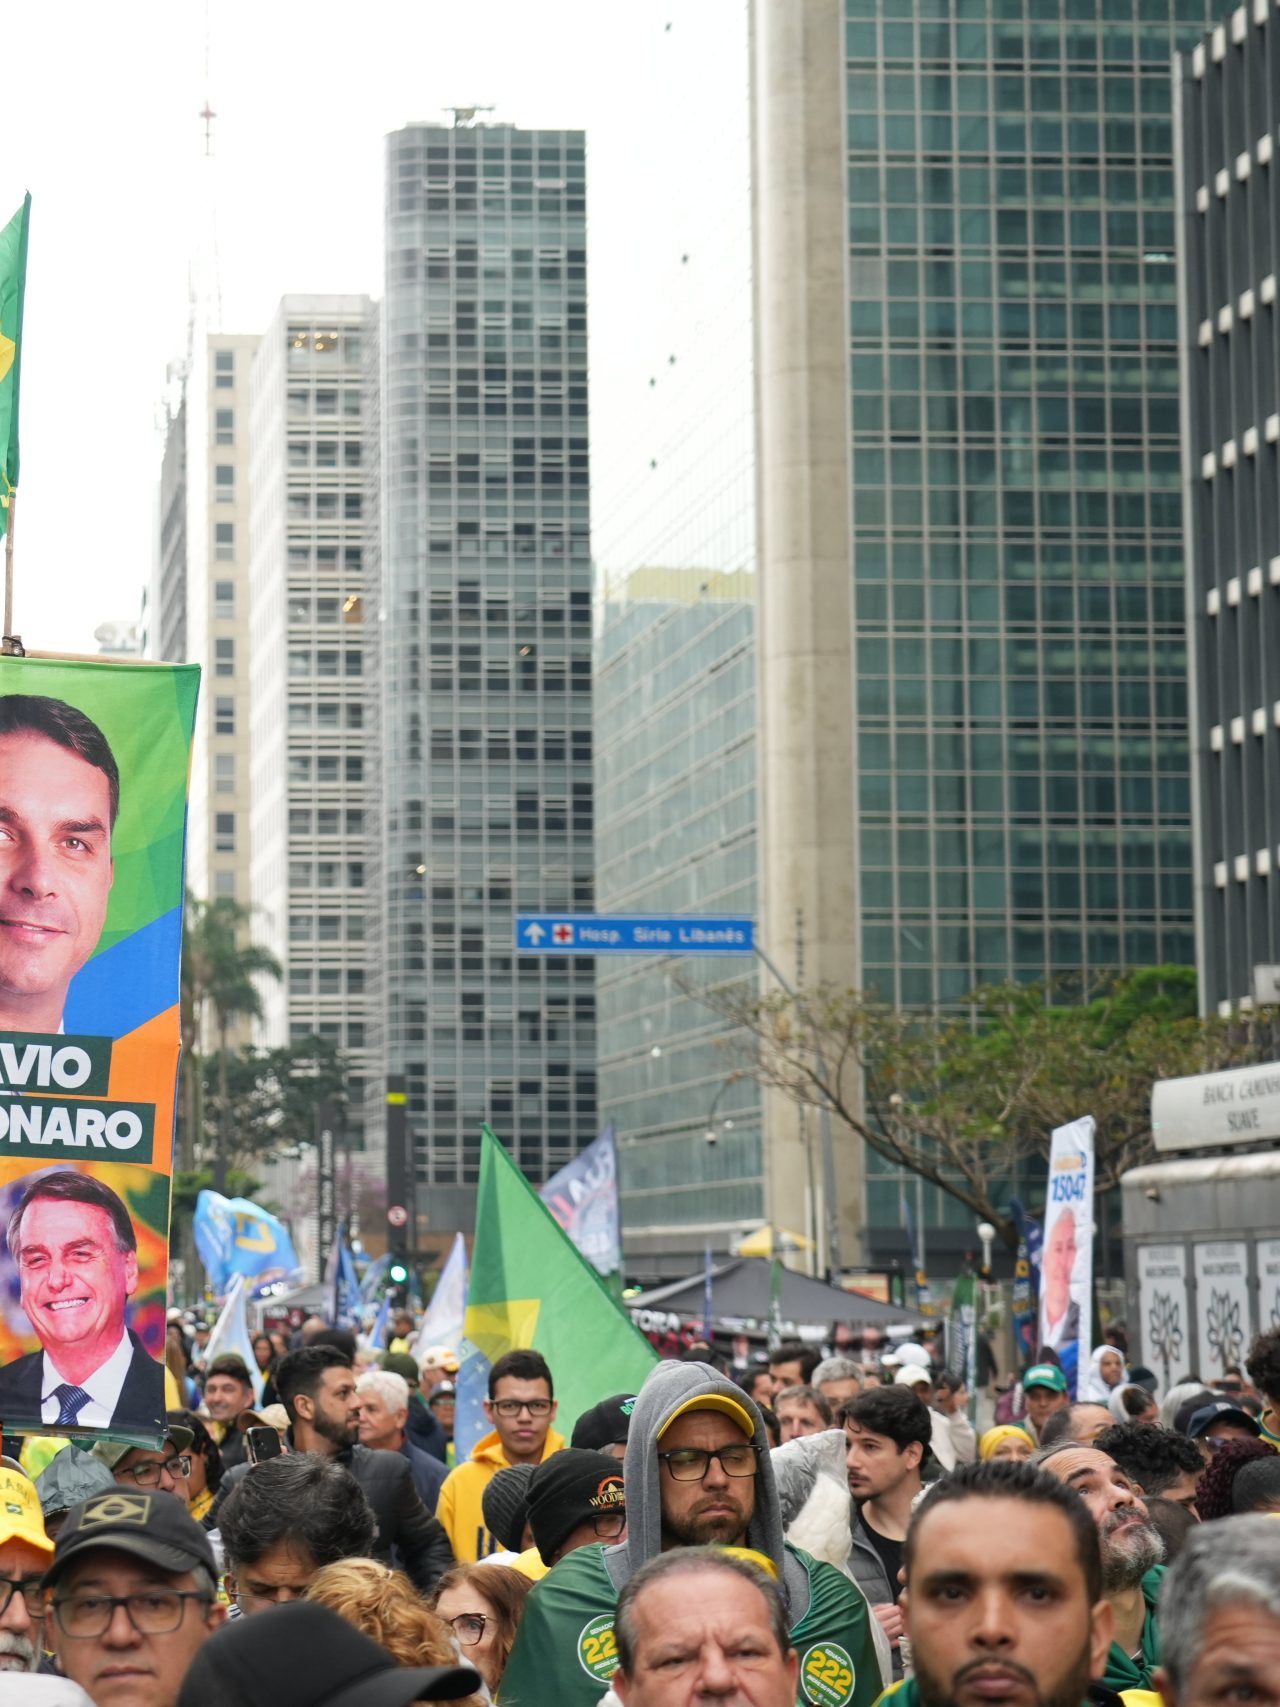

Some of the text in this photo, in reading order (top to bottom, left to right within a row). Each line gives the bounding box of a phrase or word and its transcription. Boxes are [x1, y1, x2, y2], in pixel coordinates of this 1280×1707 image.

[579, 926, 623, 944] Hosp.
[679, 926, 745, 944] Libanês
[1203, 1081, 1234, 1107] BANCA
[1227, 1107, 1261, 1133] SUAVE
[582, 1630, 619, 1665] 22
[806, 1650, 852, 1697] 222
